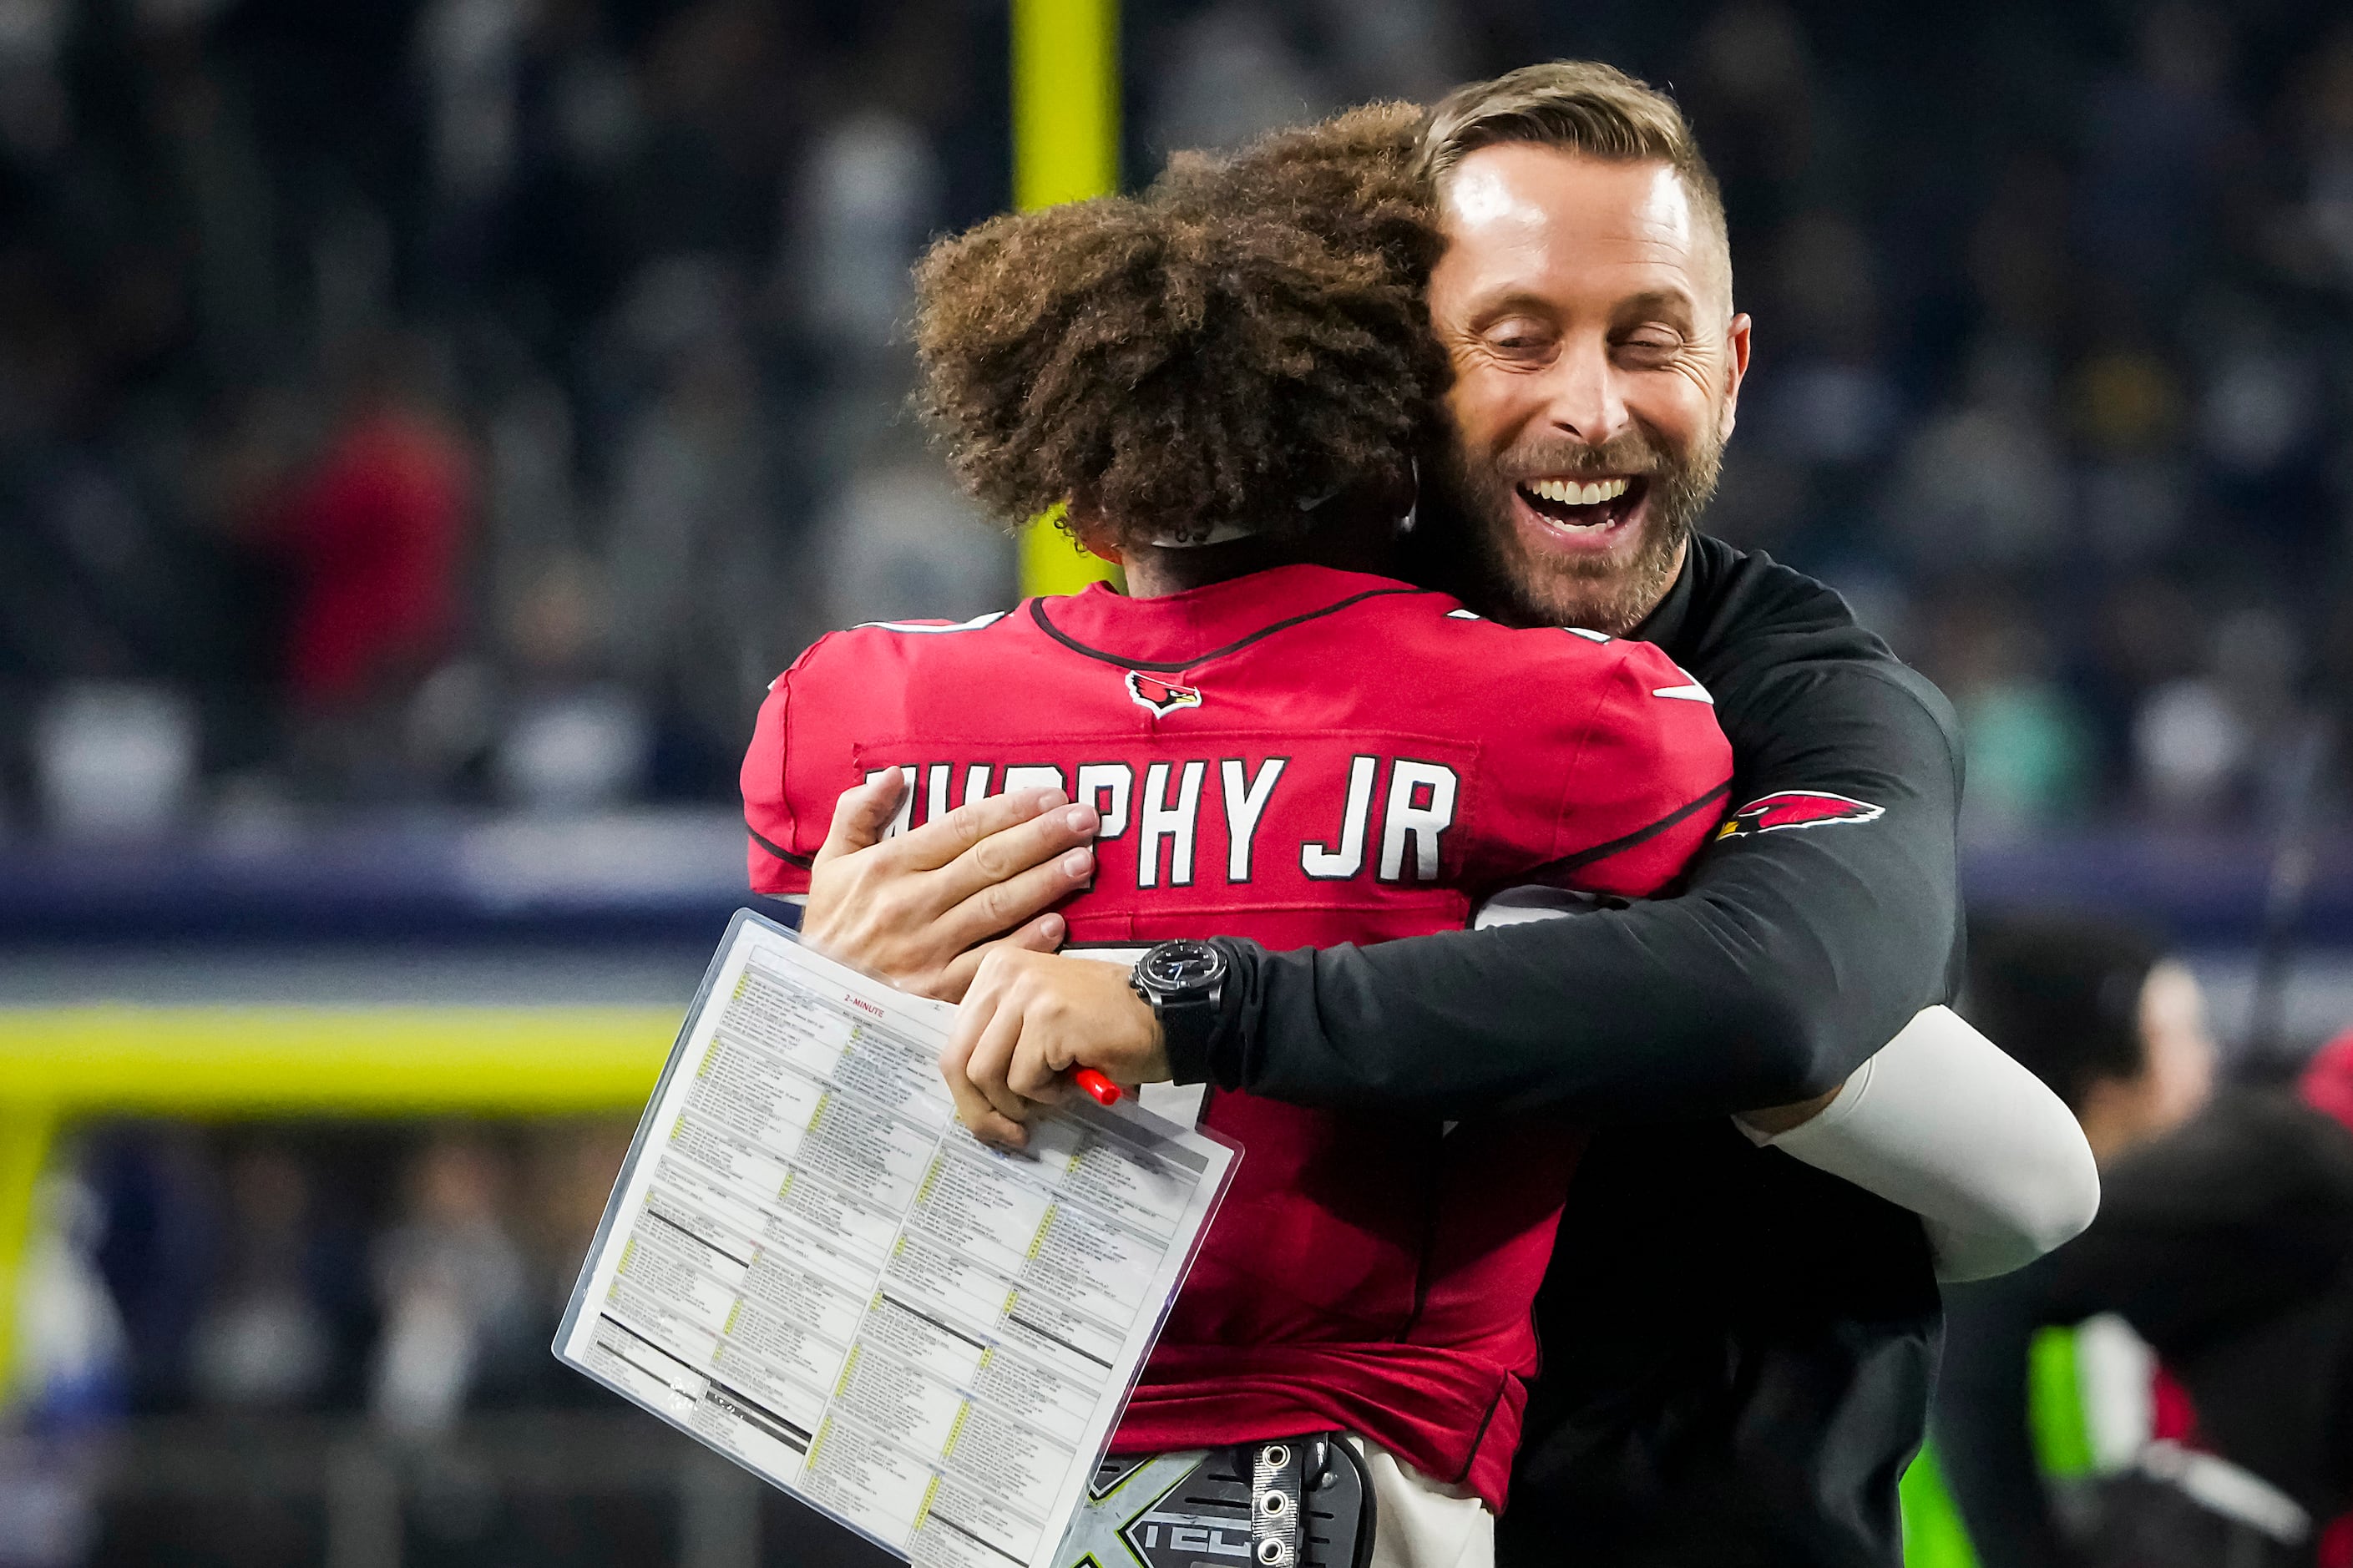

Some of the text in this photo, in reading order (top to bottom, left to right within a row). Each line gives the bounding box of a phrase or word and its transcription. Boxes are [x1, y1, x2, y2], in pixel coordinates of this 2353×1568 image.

[864, 754, 1460, 892] PHY JR
[843, 994, 885, 1018] 2-MINUTE
